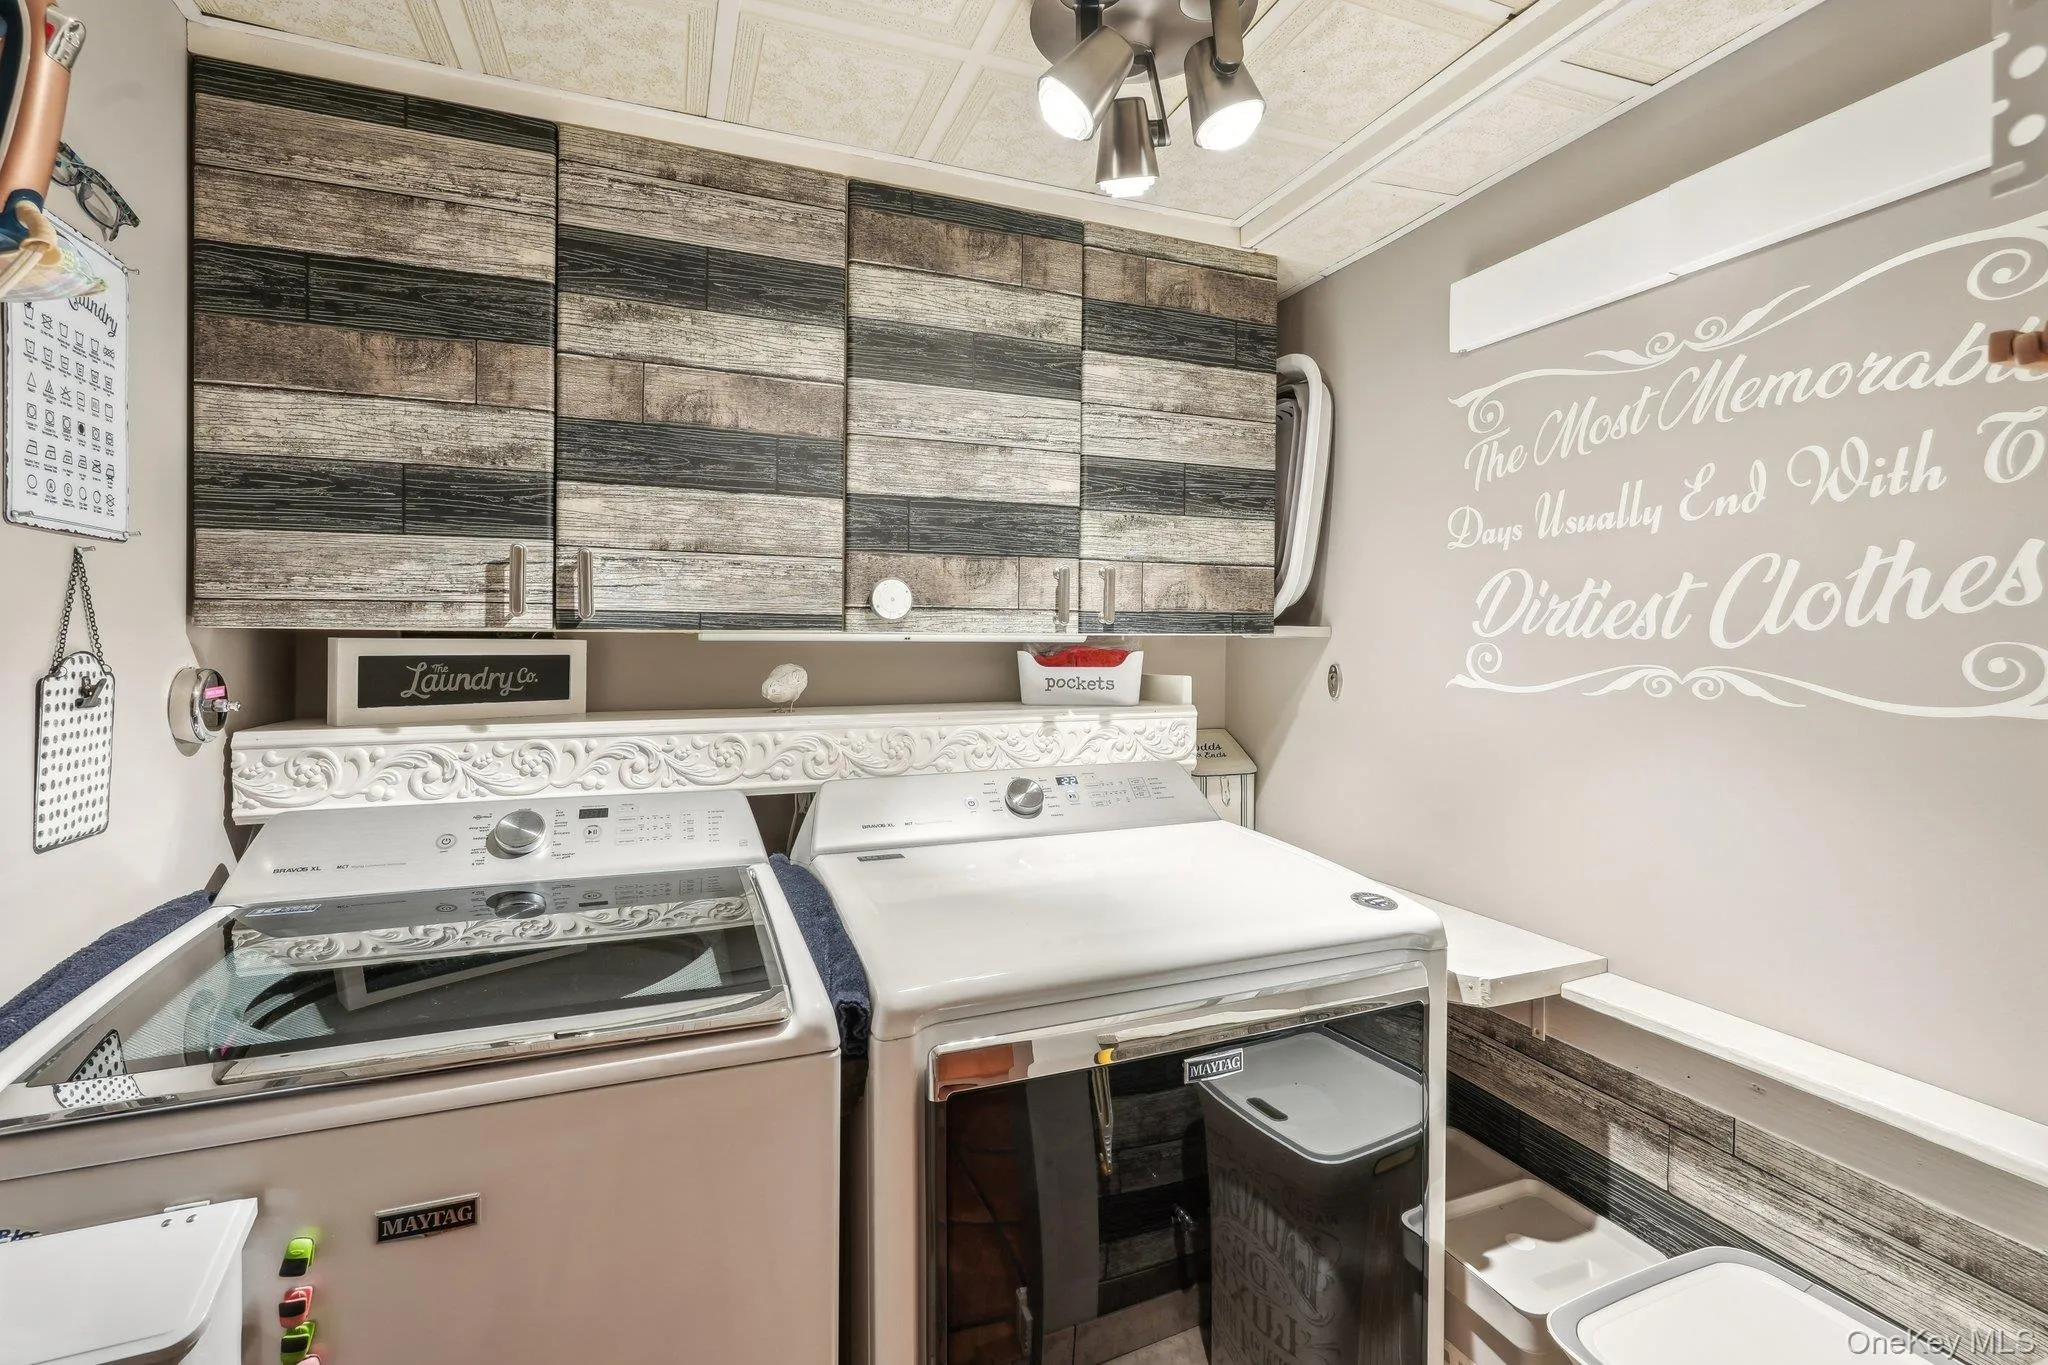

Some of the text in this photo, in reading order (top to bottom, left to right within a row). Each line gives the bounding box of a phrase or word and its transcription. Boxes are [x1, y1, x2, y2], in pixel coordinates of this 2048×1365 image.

[1464, 315, 2048, 492] The Most Memorabl
[1447, 505, 1522, 551] Days
[1535, 479, 1663, 540] Usually
[1679, 459, 1767, 523] End
[1787, 429, 1947, 506] With
[1471, 537, 2046, 651] Dirtiest Clothes
[400, 661, 539, 700] Laundry Co.
[430, 663, 449, 674] The
[1044, 676, 1115, 692] pockets
[1204, 751, 1227, 759] Ends
[272, 866, 308, 875] BRAVOS
[1189, 1056, 1241, 1078] MAYTAG
[381, 1205, 474, 1237] MAYTAG
